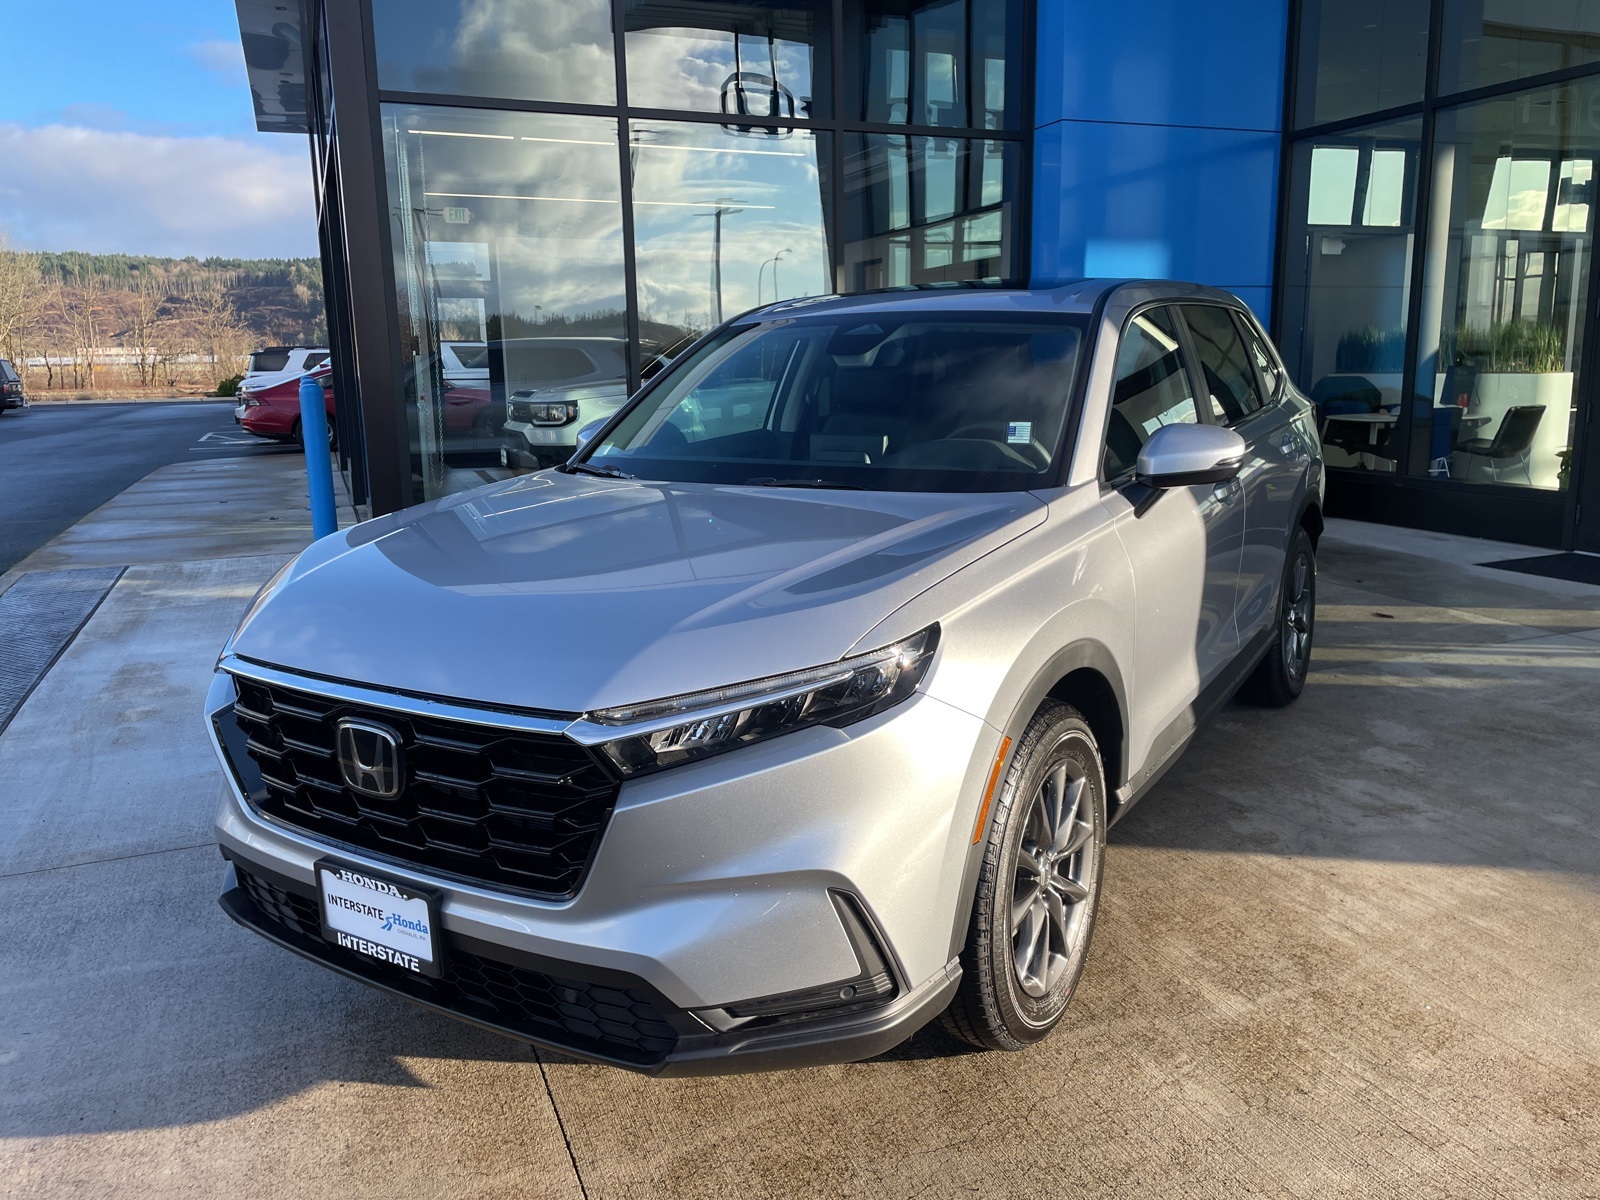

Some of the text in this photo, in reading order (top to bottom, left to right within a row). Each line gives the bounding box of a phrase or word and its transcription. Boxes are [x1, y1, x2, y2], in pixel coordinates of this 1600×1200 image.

[449, 208, 465, 221] EXIT
[340, 870, 402, 899] HONDA
[328, 893, 429, 935] INTERSTATE Honda
[337, 932, 420, 973] INTERSTATE
